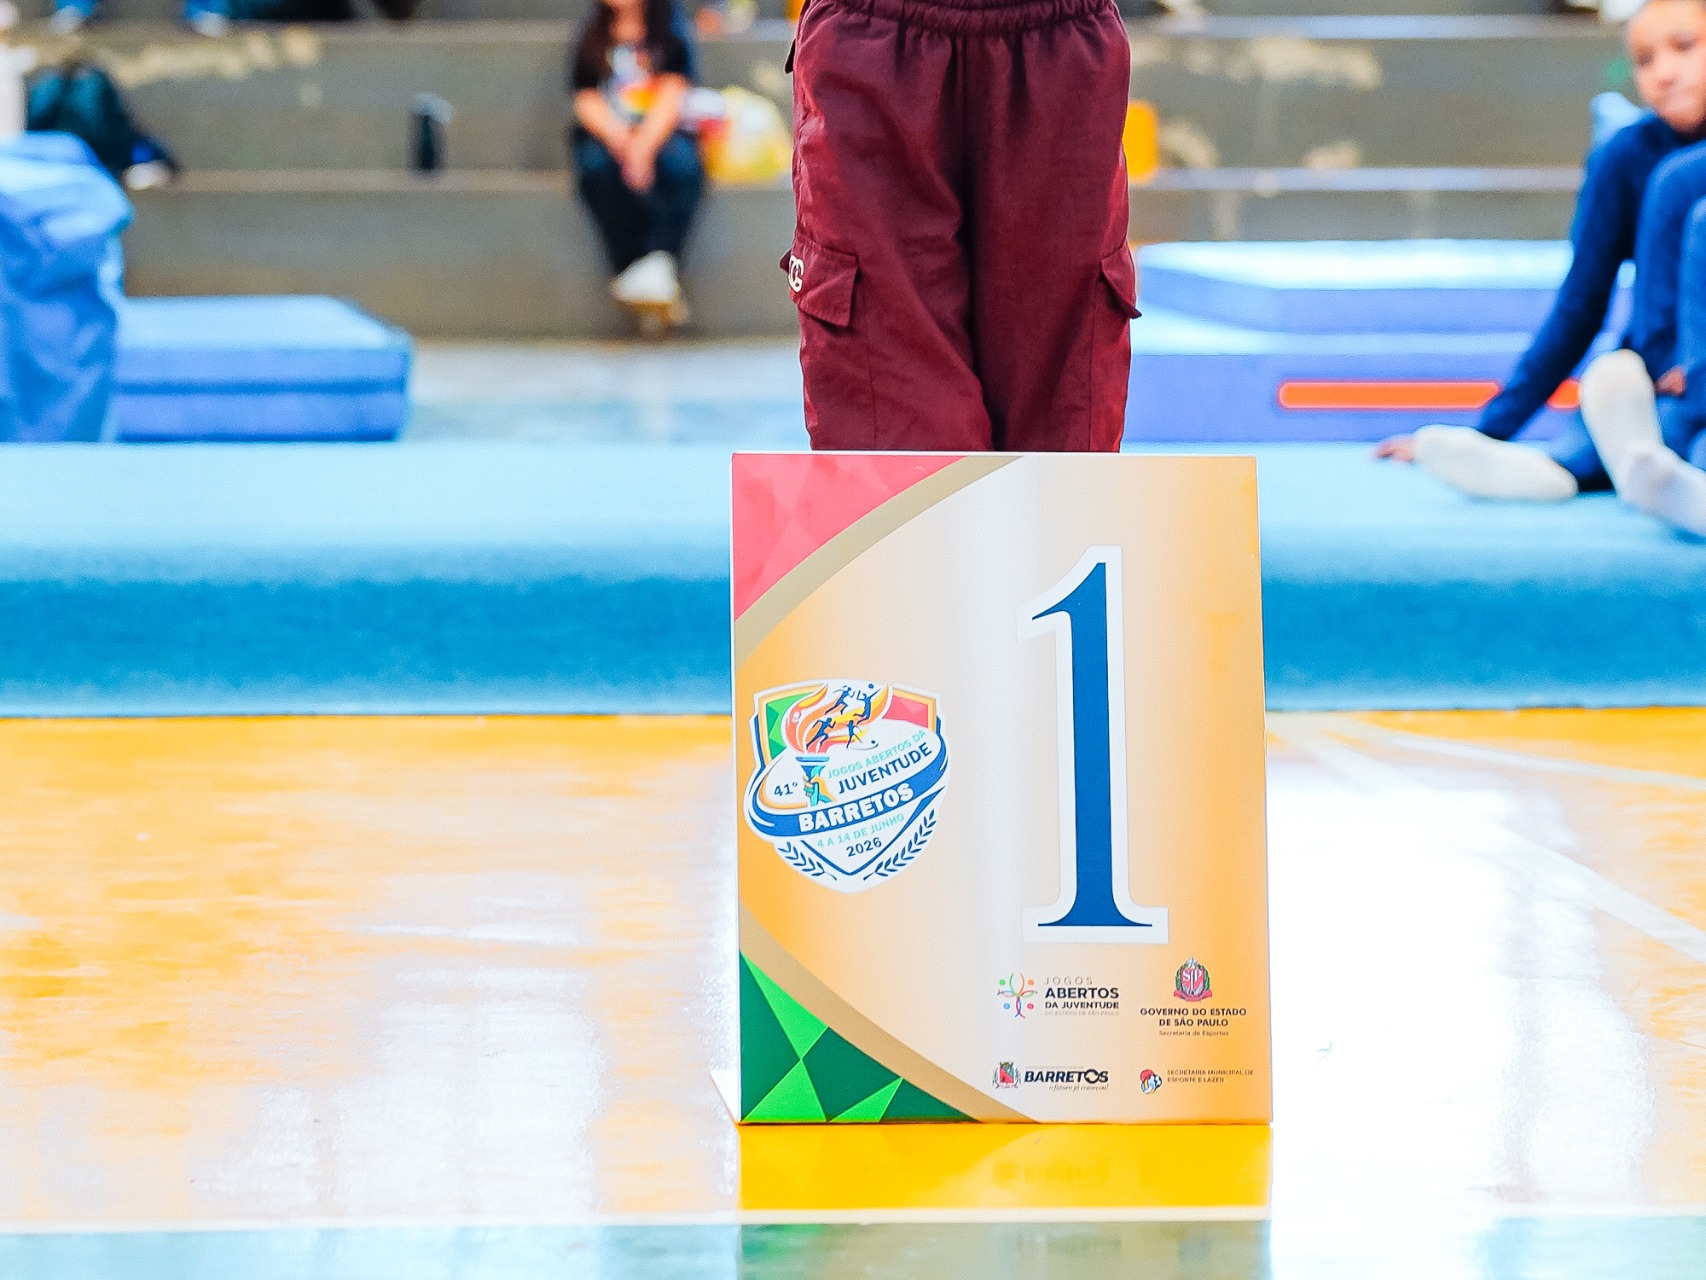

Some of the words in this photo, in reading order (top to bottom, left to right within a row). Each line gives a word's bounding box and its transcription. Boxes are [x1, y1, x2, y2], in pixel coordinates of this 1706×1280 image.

[827, 760, 863, 779] JOGOS
[865, 738, 912, 767] ABERTOS
[912, 729, 926, 743] DA
[1025, 554, 1160, 935] 1
[838, 741, 933, 795] JUVENTUDE
[798, 782, 914, 833] BARRETOS
[817, 839, 824, 848] 4
[827, 836, 835, 846] A
[837, 833, 850, 843] 14
[853, 826, 868, 839] DE
[870, 813, 905, 835] JUNHO
[846, 836, 882, 858] 2026
[1044, 976, 1093, 986] JOGOS
[1045, 987, 1120, 999] ABERTOS
[1045, 1001, 1059, 1009] DA
[1061, 1001, 1120, 1009] JUVENTUDE
[1140, 1007, 1189, 1016] GOVERNO
[1192, 1007, 1207, 1016] DO
[1210, 1007, 1247, 1016] ESTADO
[1159, 1018, 1171, 1027] DE
[1174, 1017, 1194, 1027] SÃO
[1197, 1018, 1229, 1027] PAULO
[1024, 1068, 1109, 1084] BARRETOS
